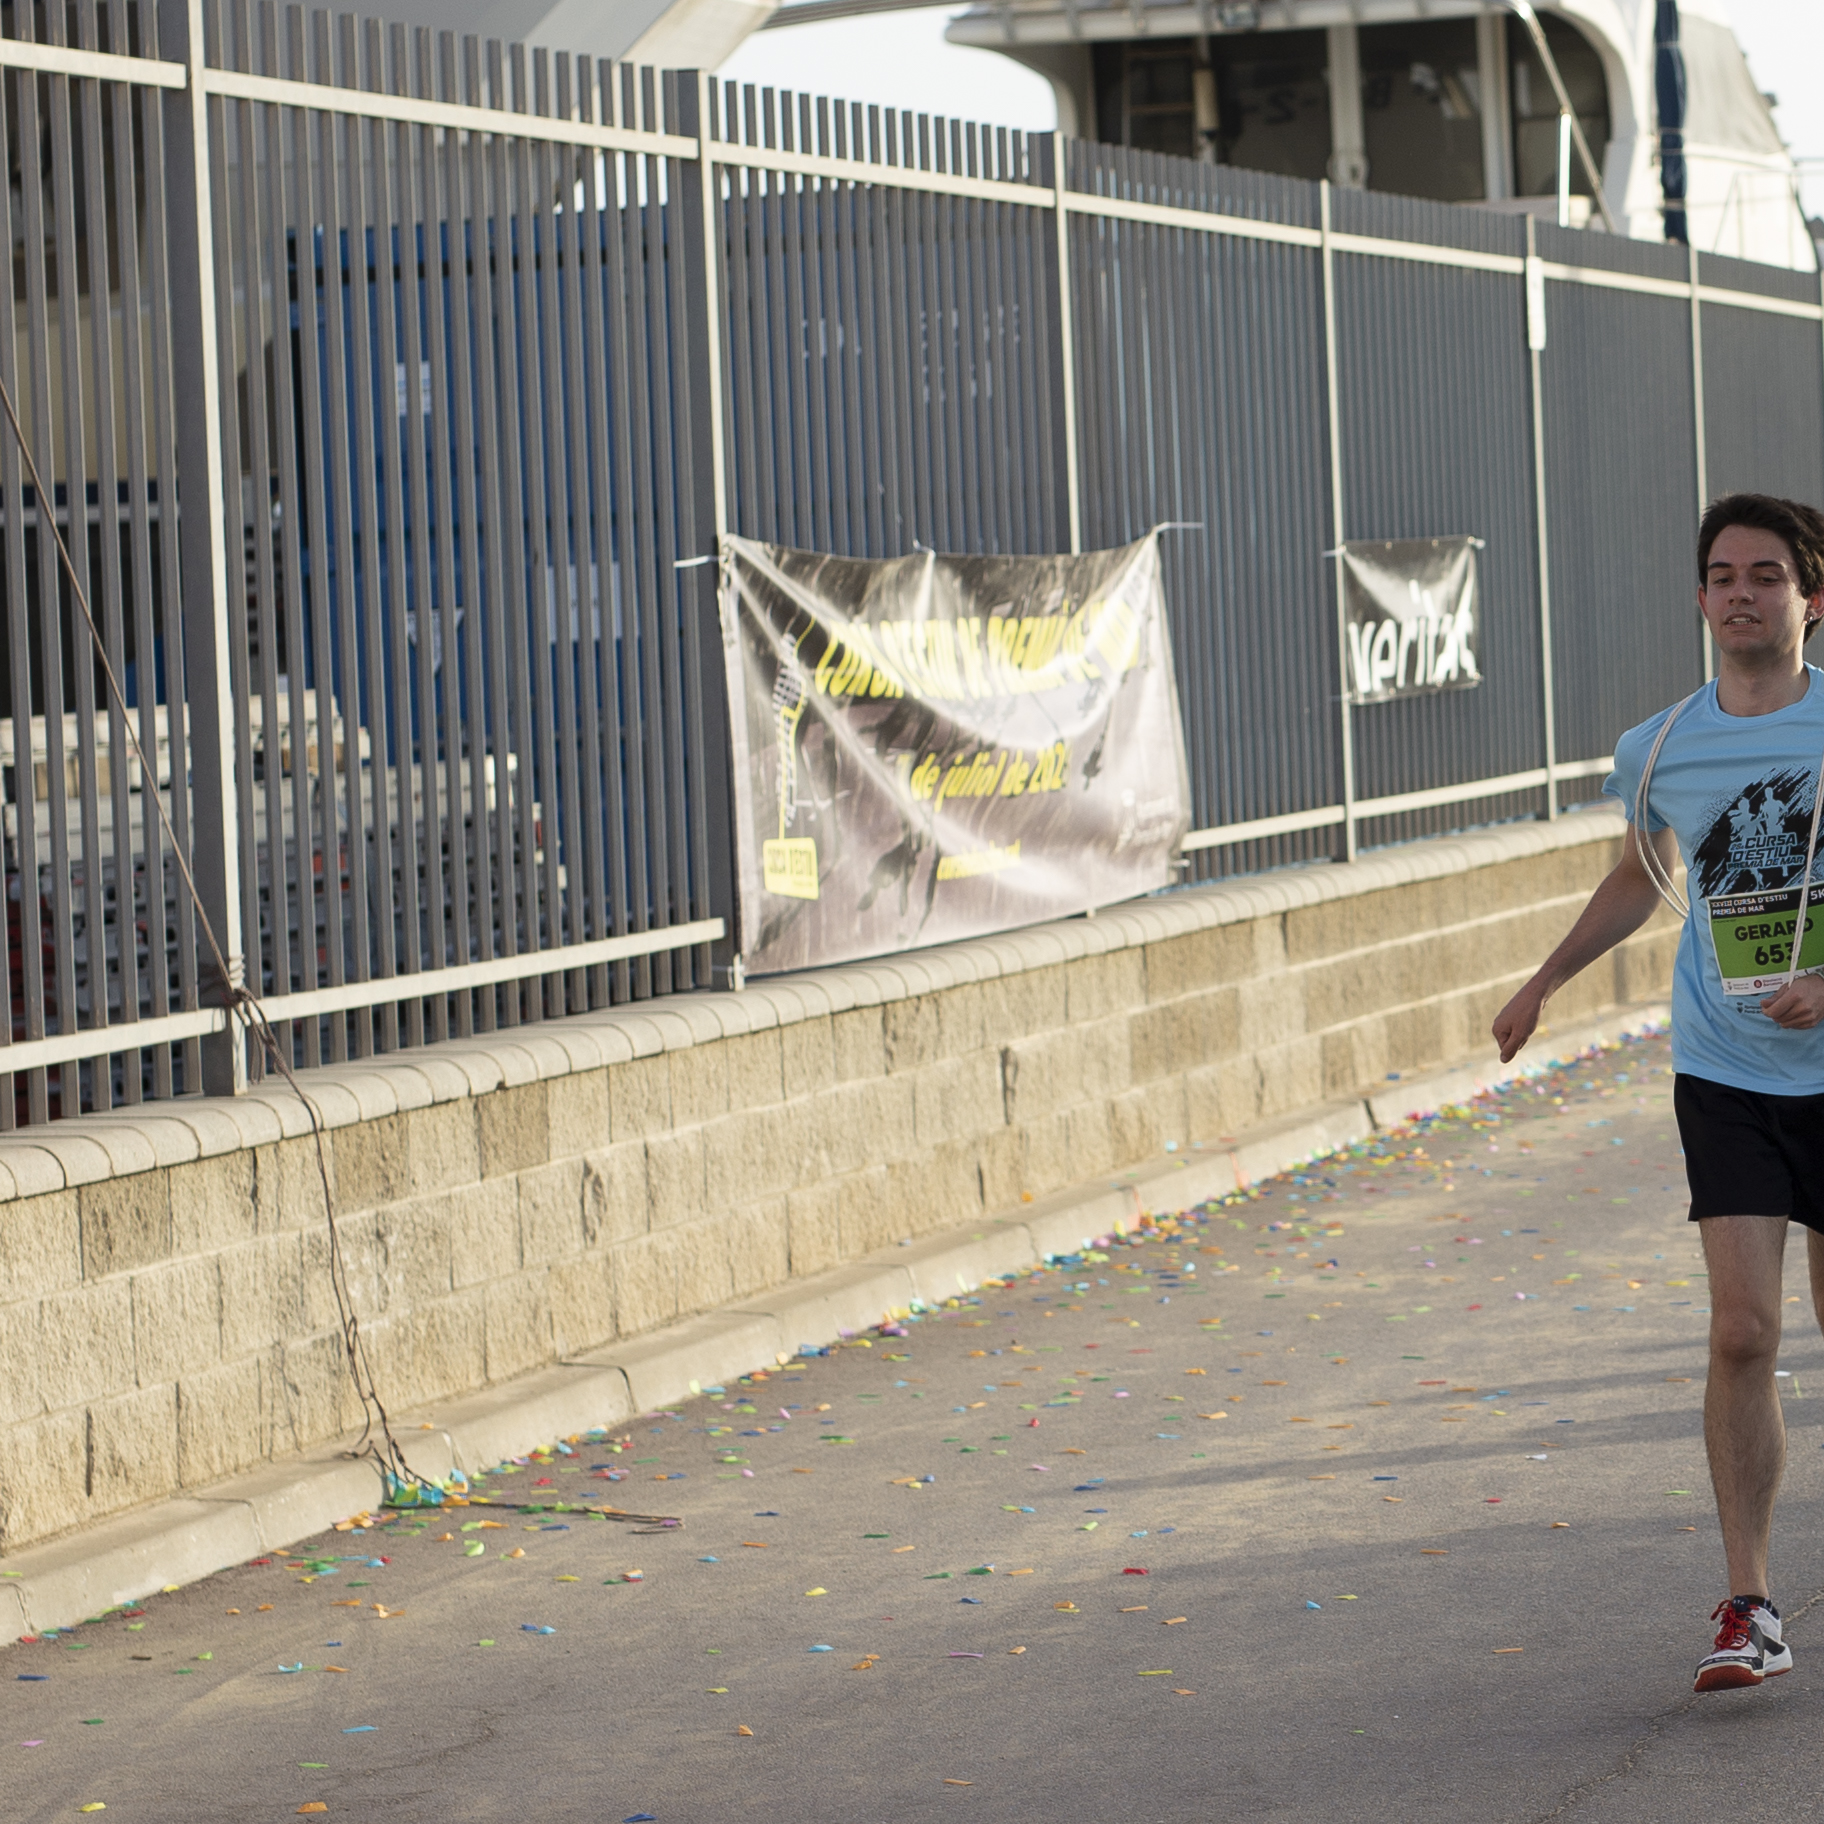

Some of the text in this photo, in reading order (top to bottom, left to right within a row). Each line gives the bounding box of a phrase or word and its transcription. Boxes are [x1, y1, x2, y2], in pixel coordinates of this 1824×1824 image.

[910, 752, 942, 801] de
[934, 751, 1009, 813] juliol
[1000, 748, 1030, 797] de
[1028, 741, 1070, 794] 202
[1745, 833, 1796, 849] CURSA
[1733, 846, 1790, 862] D'ESTIU
[1765, 858, 1779, 866] DE
[1780, 856, 1804, 865] MAR
[1733, 897, 1756, 907] CURSA
[1757, 893, 1788, 904] D'ESTIU
[1748, 905, 1765, 913] MAR
[1734, 917, 1814, 942] GERARD
